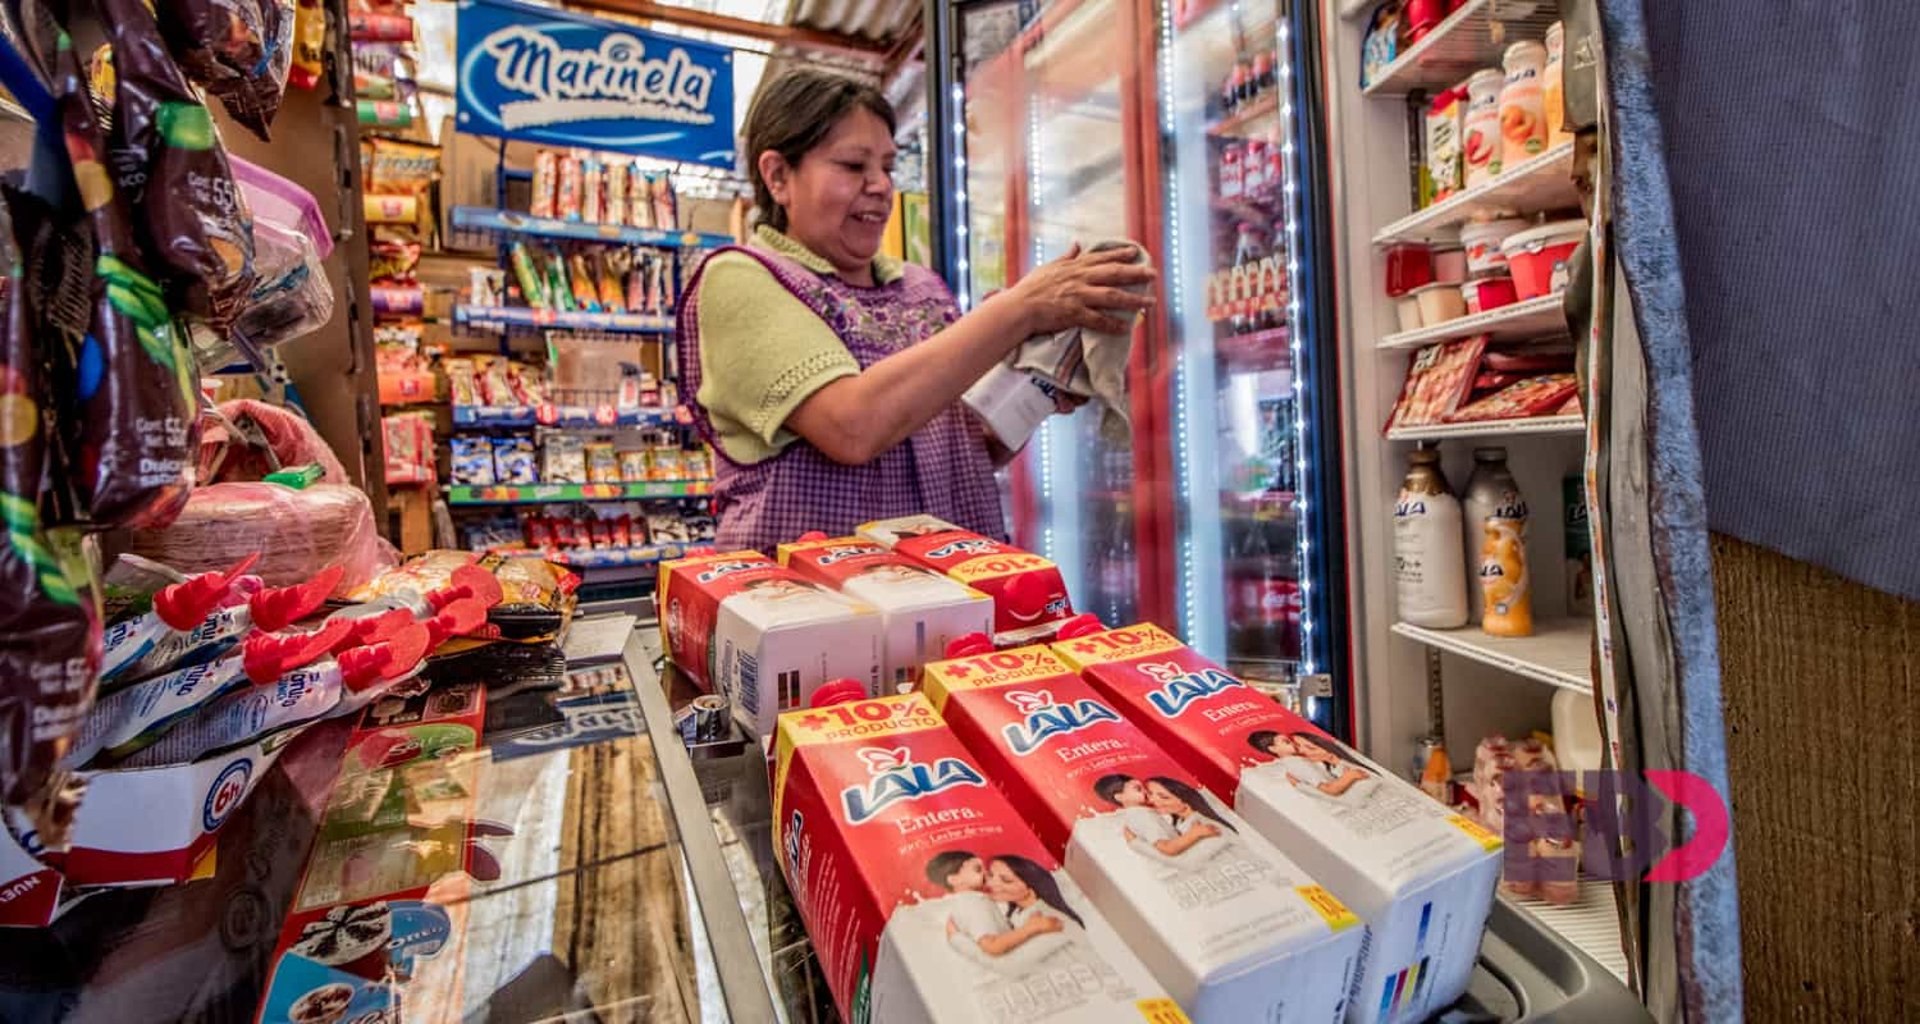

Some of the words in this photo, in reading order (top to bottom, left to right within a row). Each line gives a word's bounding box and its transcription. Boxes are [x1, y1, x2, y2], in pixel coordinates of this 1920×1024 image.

[488, 30, 710, 104] Marinela
[1073, 629, 1171, 655] +10%
[944, 653, 1057, 679] +10%
[973, 665, 1066, 687] PRODUCTO
[1145, 668, 1247, 720] LALA
[797, 702, 930, 731] +10%
[826, 717, 938, 740] PRODUCTO
[1002, 699, 1123, 757] LALA
[840, 757, 987, 826] LALA
